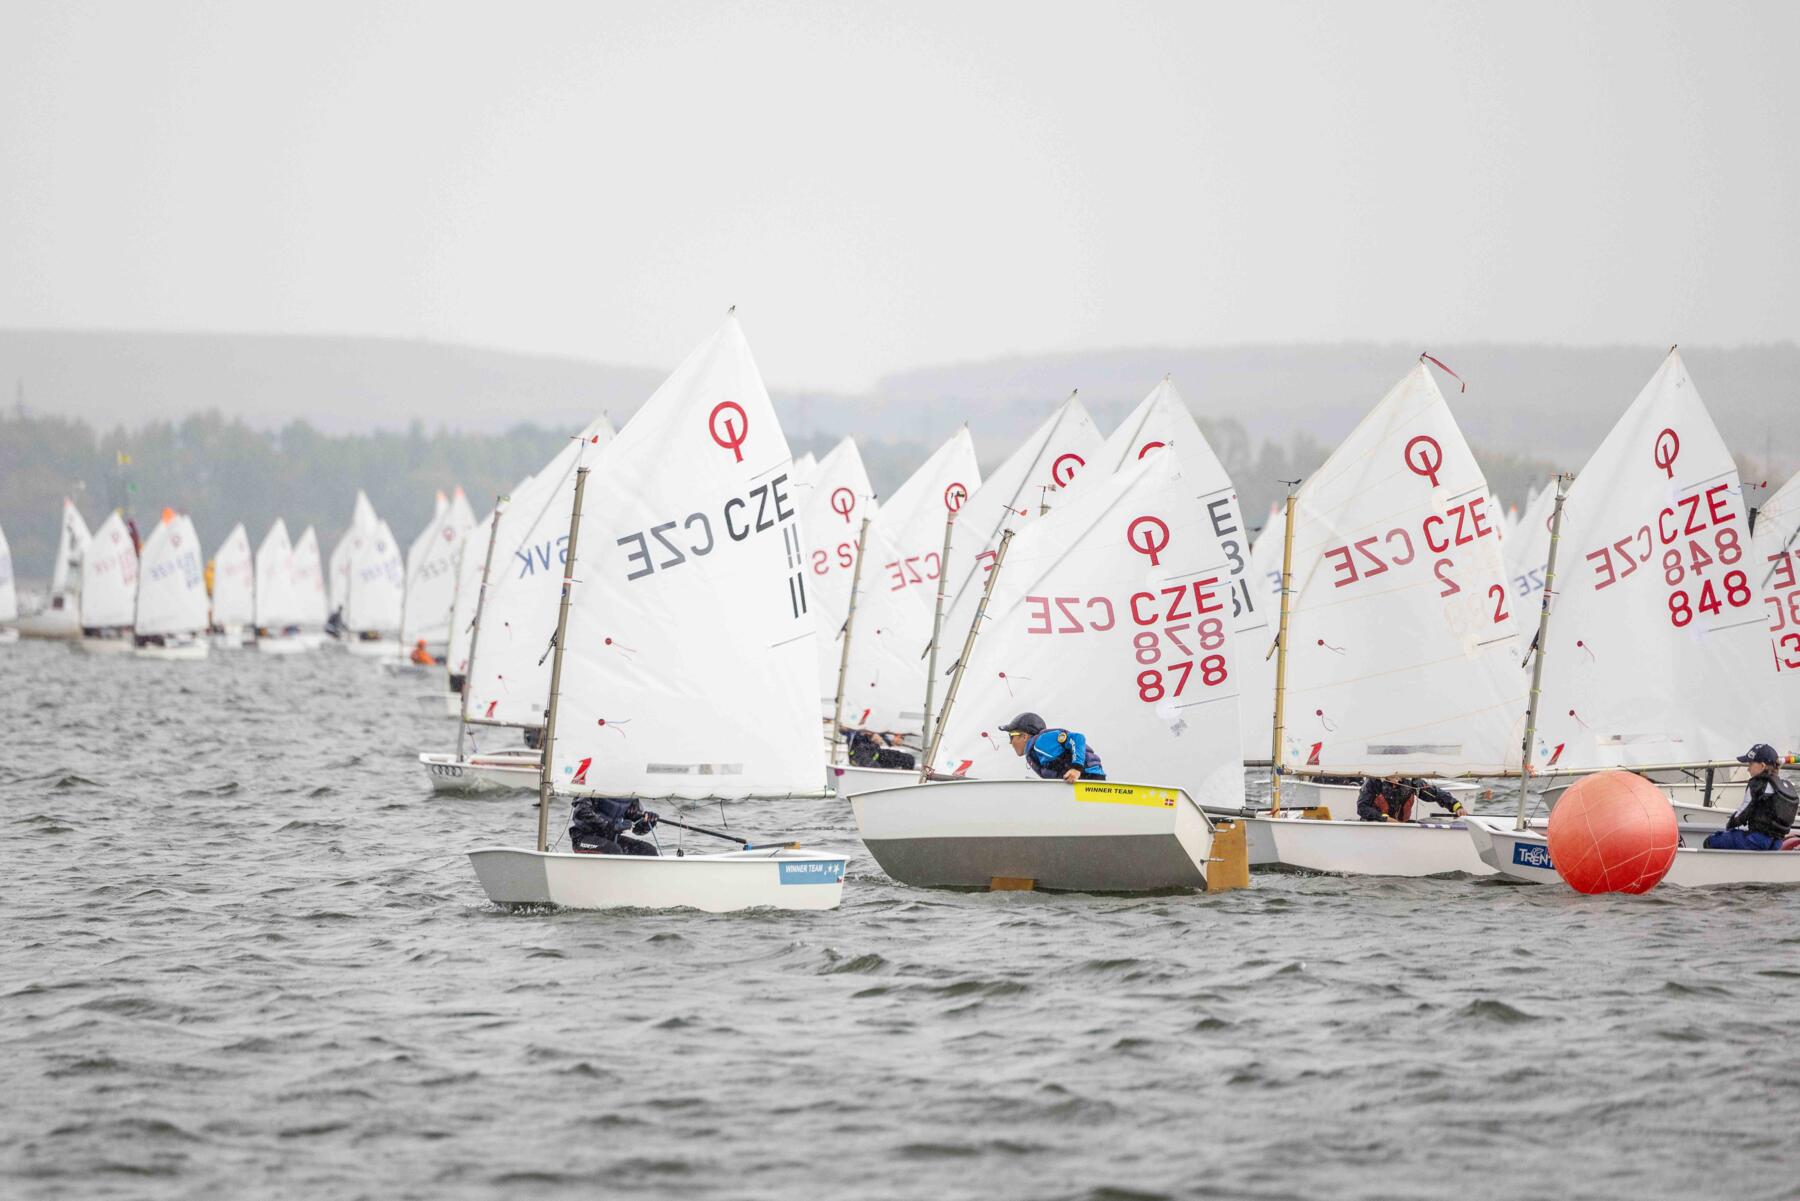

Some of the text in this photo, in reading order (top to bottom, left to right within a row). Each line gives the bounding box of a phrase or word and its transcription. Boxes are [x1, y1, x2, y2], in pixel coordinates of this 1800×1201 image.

[724, 473, 795, 546] CZE
[1422, 497, 1492, 553] CZE
[1658, 483, 1736, 545] CZE
[1130, 577, 1223, 626] CZE
[1488, 584, 1509, 624] 2
[1668, 569, 1751, 627] 848
[1137, 654, 1228, 703] 878
[785, 864, 823, 873] WINNER TEAM
